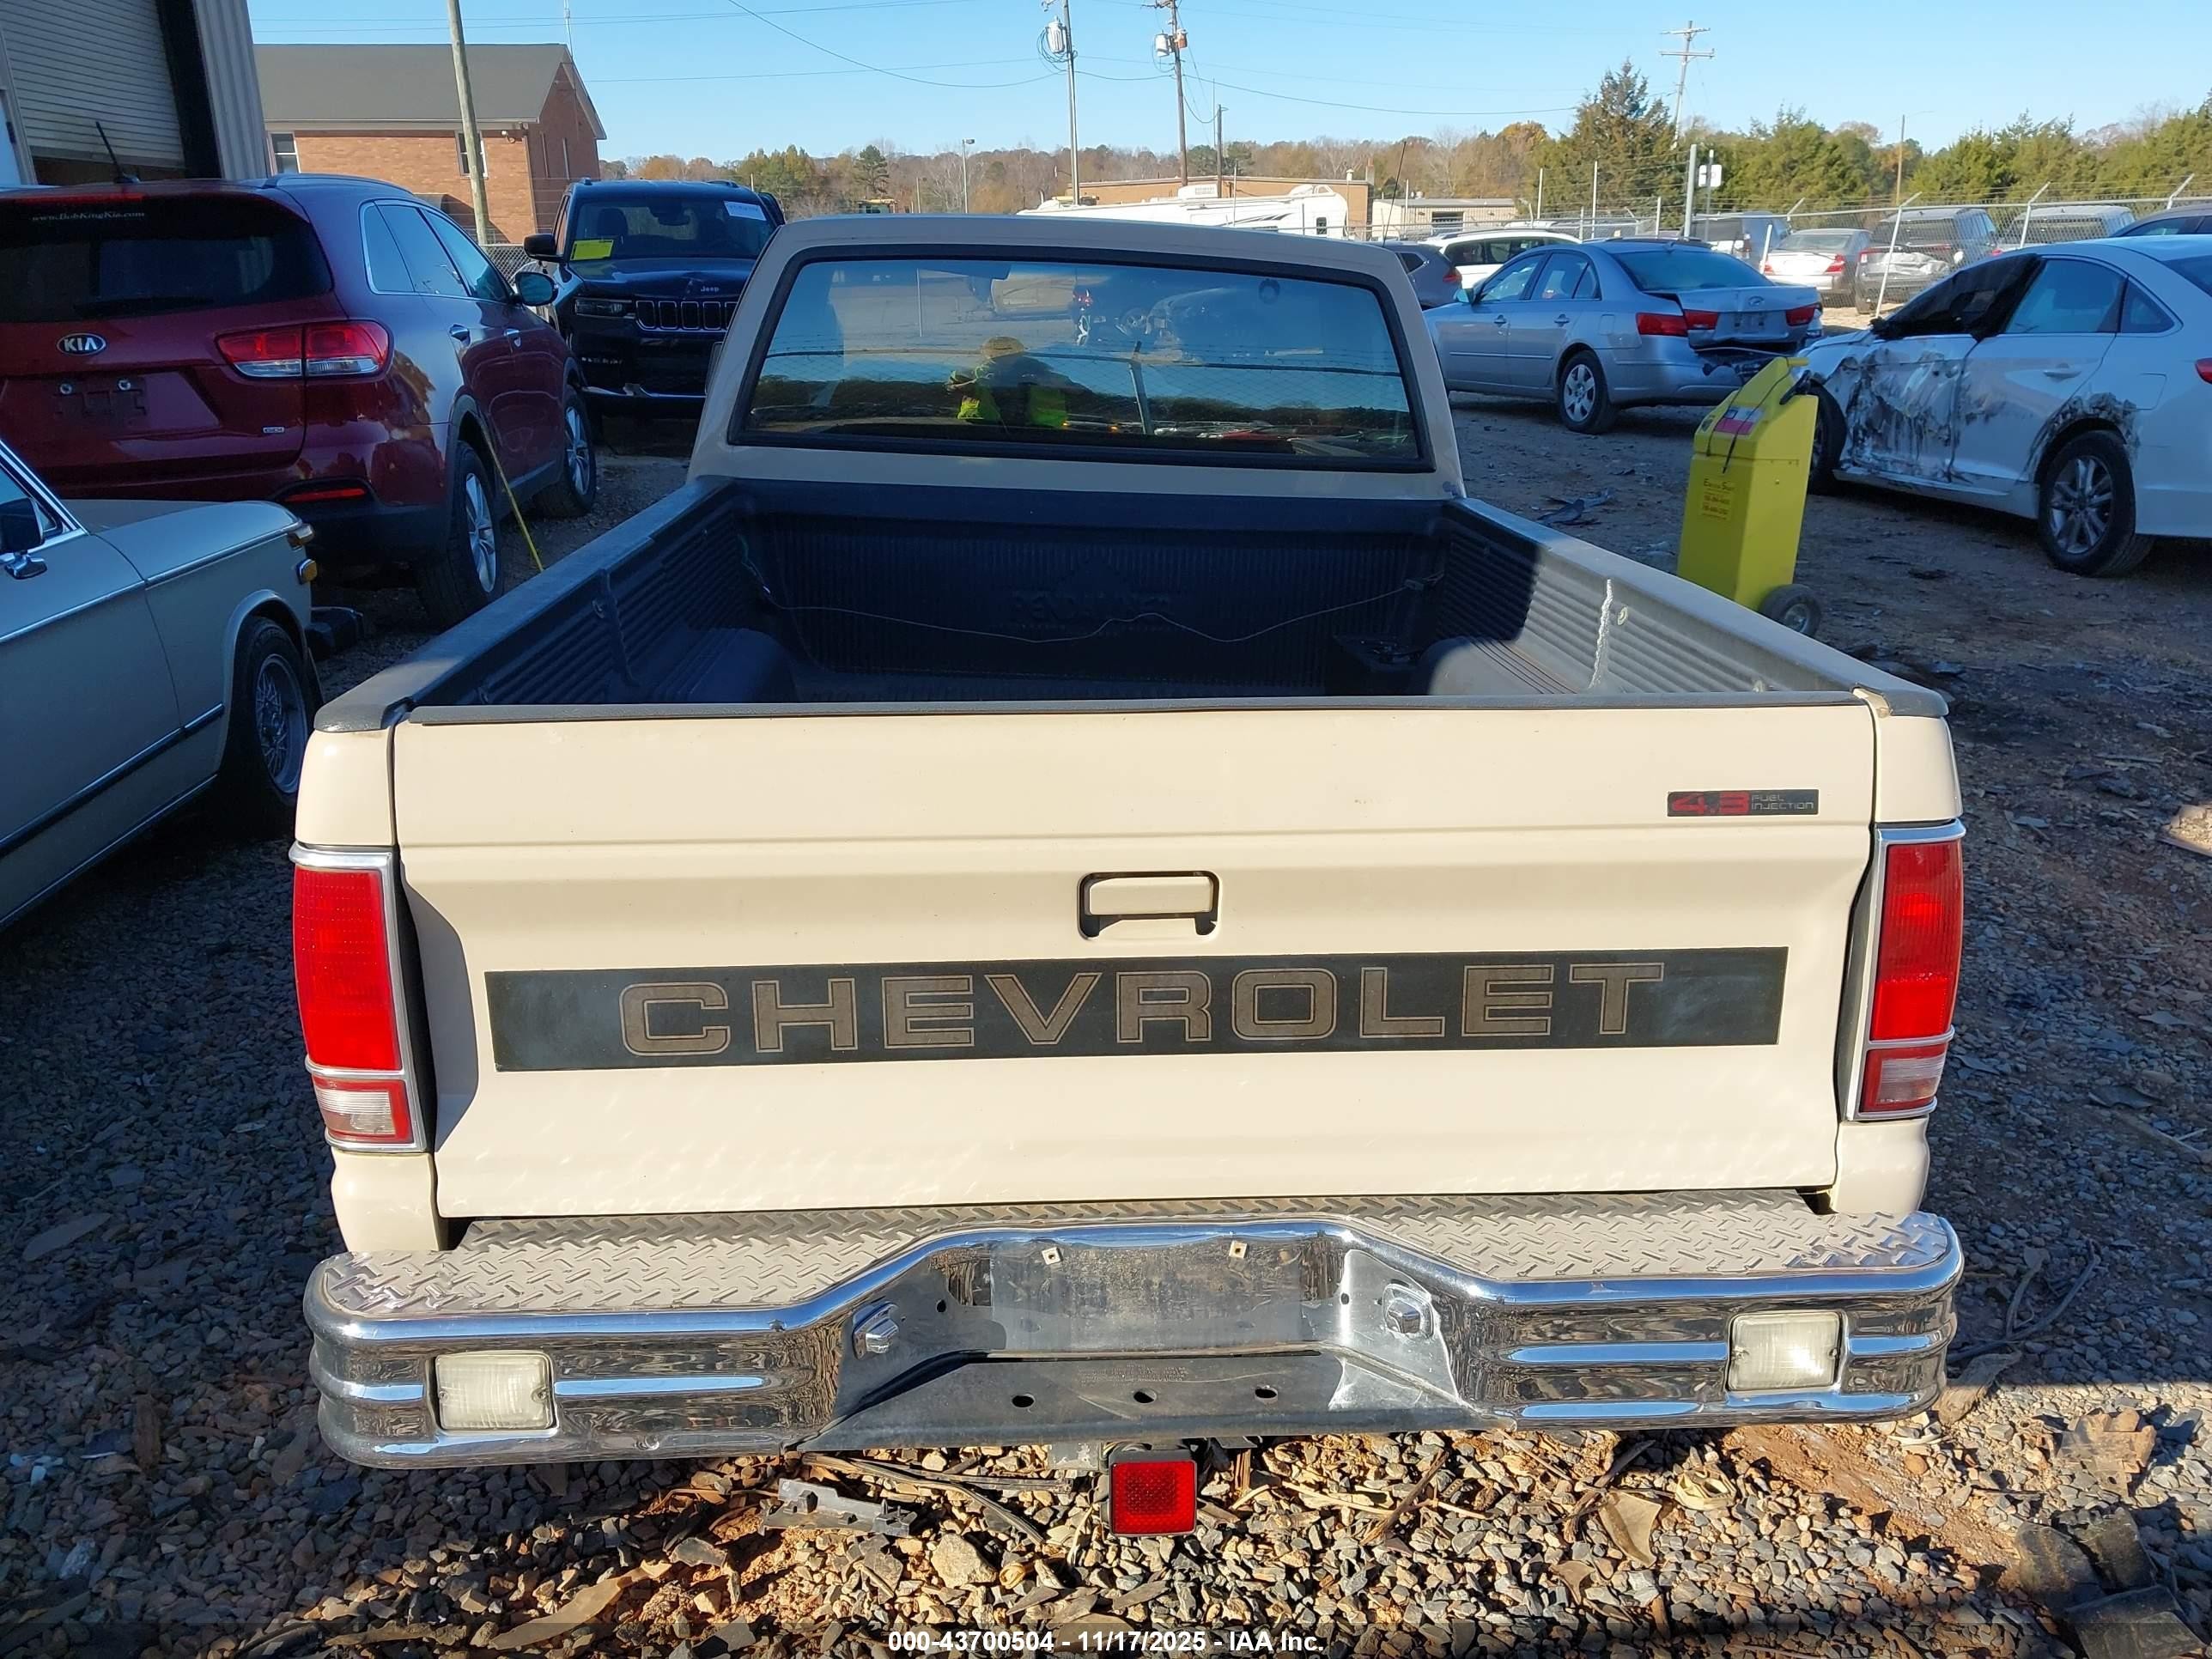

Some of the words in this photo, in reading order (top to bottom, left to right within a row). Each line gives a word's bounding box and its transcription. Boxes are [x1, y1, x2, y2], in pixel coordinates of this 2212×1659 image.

[64, 337, 98, 351] KIA
[1672, 790, 1751, 815] 4.3
[1751, 793, 1784, 802] FUEL
[1751, 801, 1814, 811] INJECTION
[619, 961, 1665, 1056] CHEVROLET
